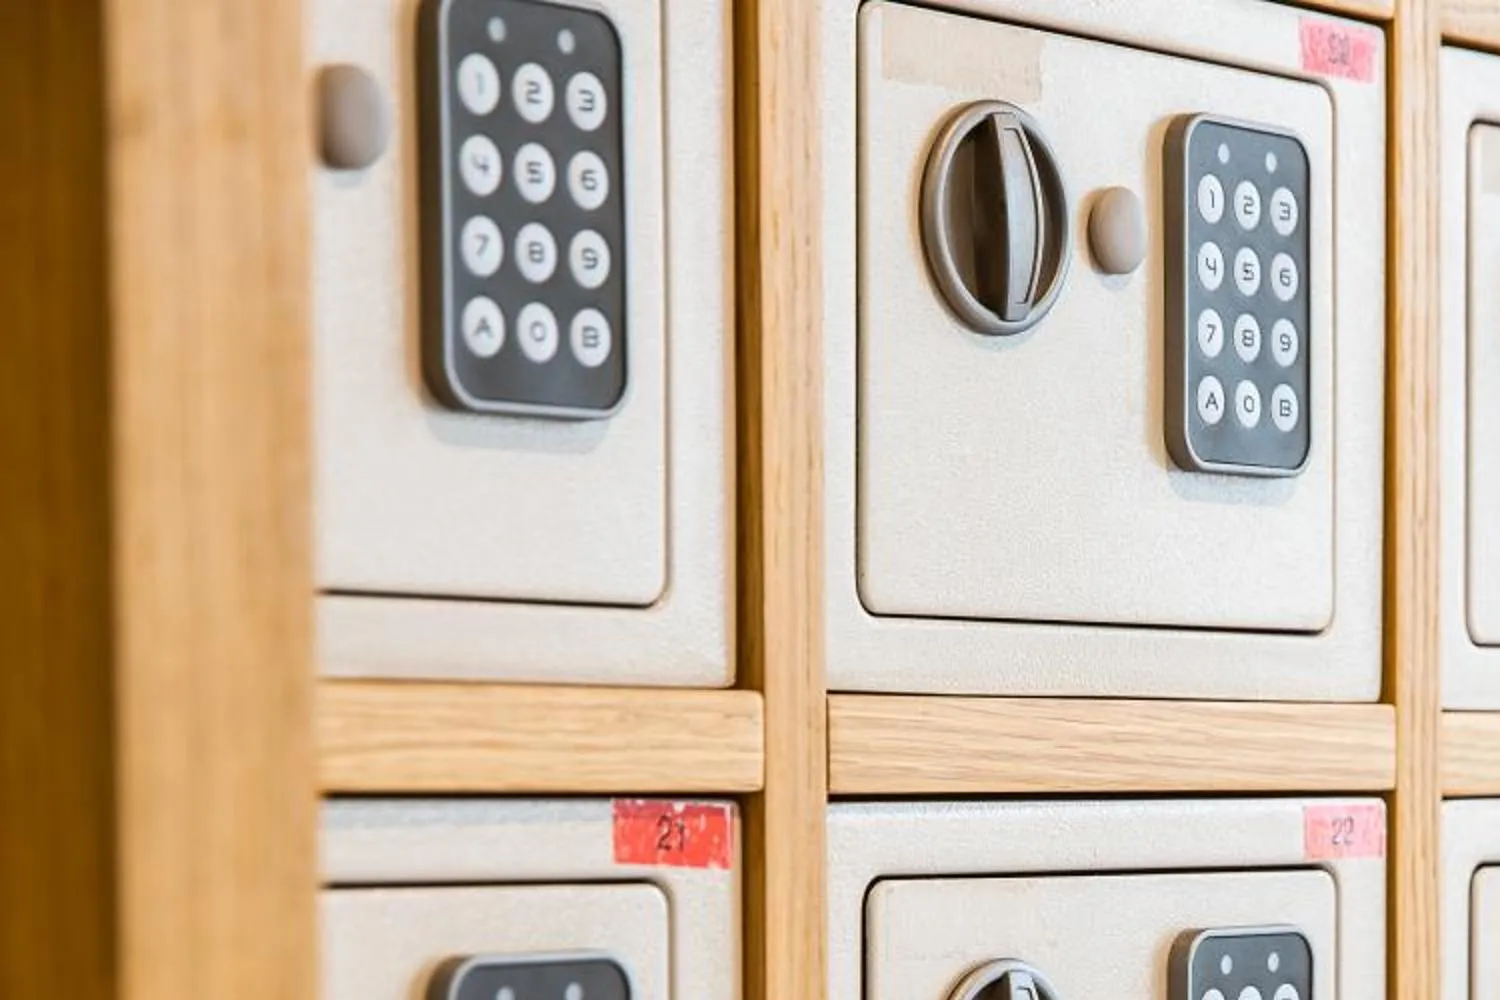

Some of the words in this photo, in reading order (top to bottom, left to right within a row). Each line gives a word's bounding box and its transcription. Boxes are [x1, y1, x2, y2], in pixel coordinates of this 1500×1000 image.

[475, 71, 488, 98] 1
[525, 80, 542, 105] 2
[578, 89, 596, 113] 3
[472, 153, 490, 177] 4
[525, 160, 543, 185] 5
[579, 168, 598, 192] 6
[1209, 189, 1215, 209] 1
[1242, 195, 1255, 215] 2
[1279, 201, 1291, 222] 3
[474, 233, 490, 257] 7
[527, 240, 545, 264] 8
[581, 247, 599, 271] 9
[1205, 257, 1217, 277] 4
[1242, 262, 1255, 282] 5
[1279, 268, 1291, 288] 6
[472, 316, 492, 337] A
[581, 325, 600, 349] B
[1206, 323, 1217, 344] 7
[1241, 328, 1255, 348] 8
[1279, 332, 1293, 353] 9
[1204, 391, 1219, 411] A
[1279, 398, 1292, 418] B
[656, 813, 686, 851] 21
